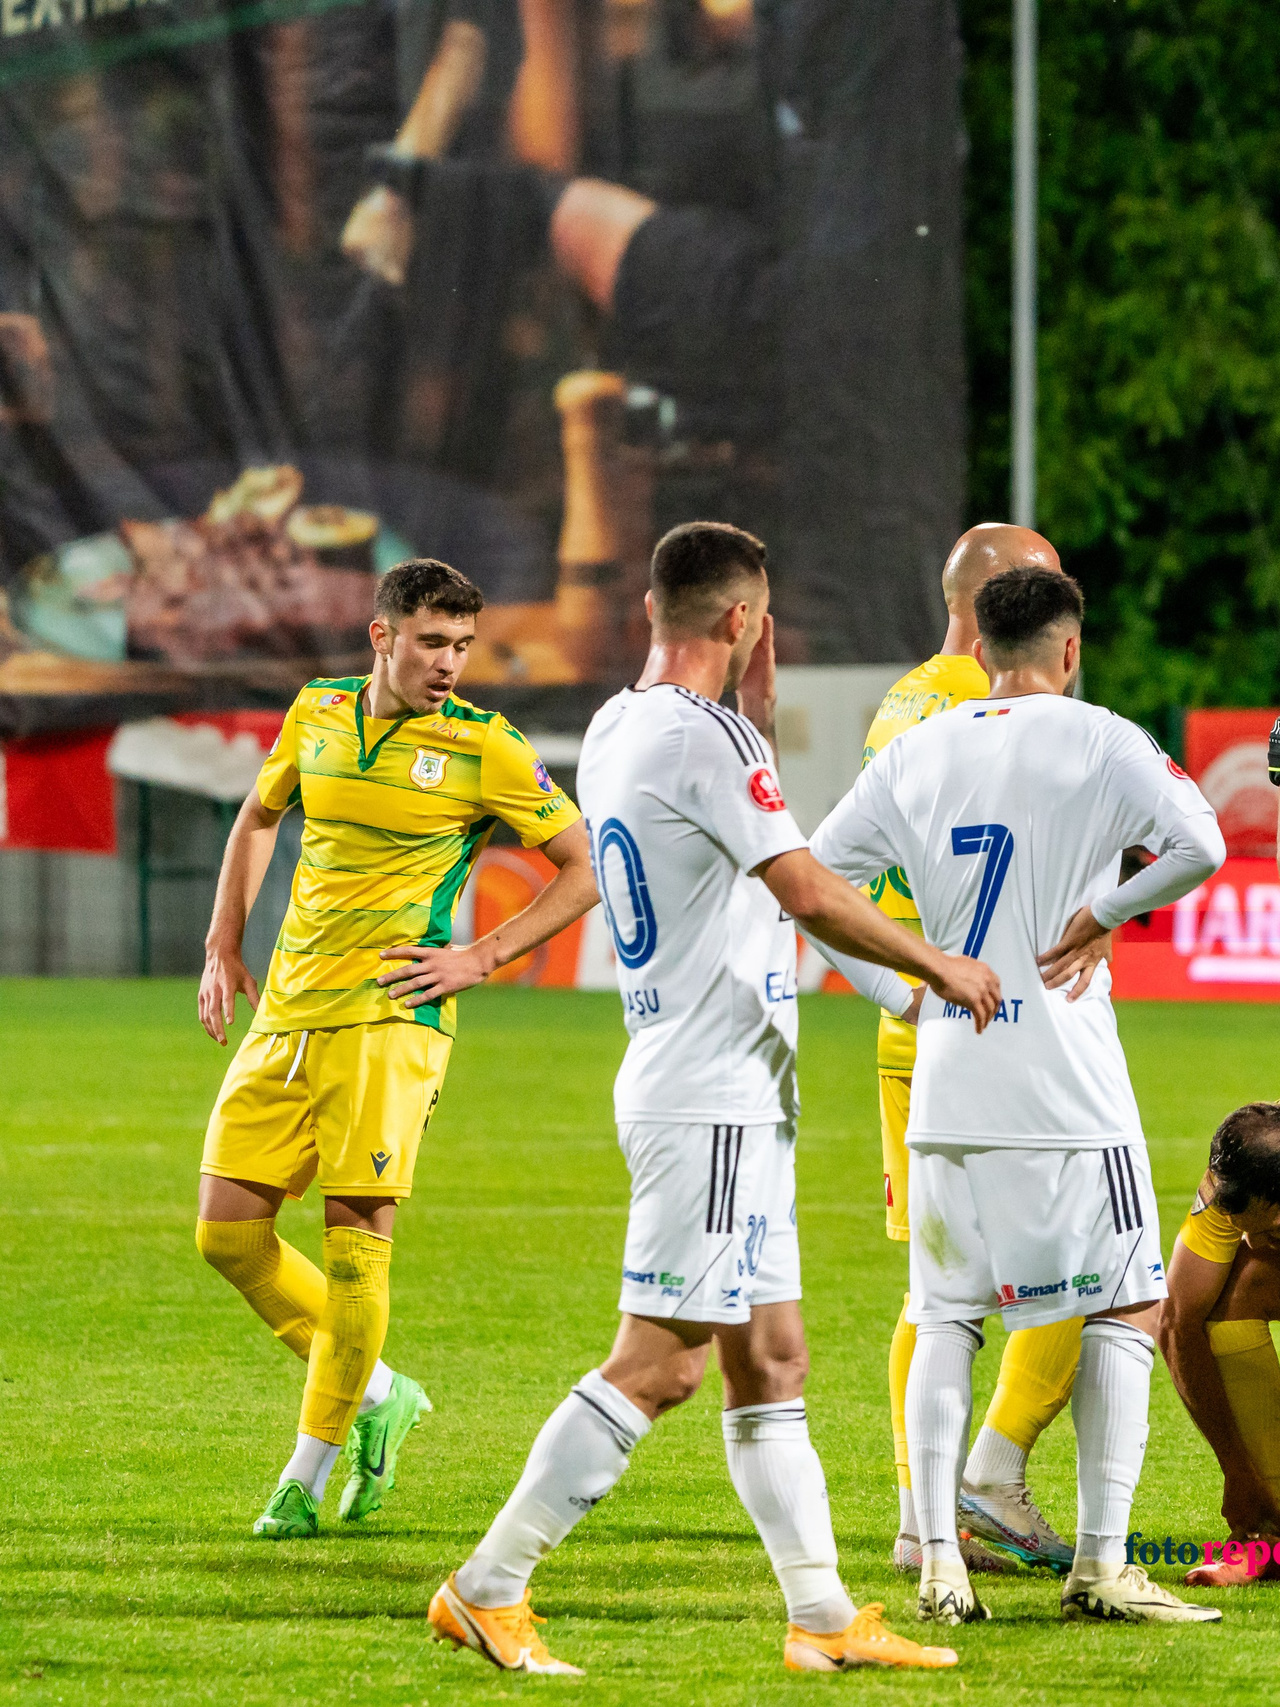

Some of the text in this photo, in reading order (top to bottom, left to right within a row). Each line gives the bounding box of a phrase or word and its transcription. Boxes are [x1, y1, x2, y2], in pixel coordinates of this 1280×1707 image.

[535, 792, 571, 821] MIOV
[584, 817, 657, 969] 0
[951, 824, 1014, 960] 7
[765, 971, 798, 1003] EL
[943, 999, 1023, 1023] MAAT
[659, 1273, 685, 1286] Eco
[661, 1287, 683, 1297] Plus
[1018, 1273, 1100, 1299] Smart Eco
[1078, 1284, 1103, 1297] Plus
